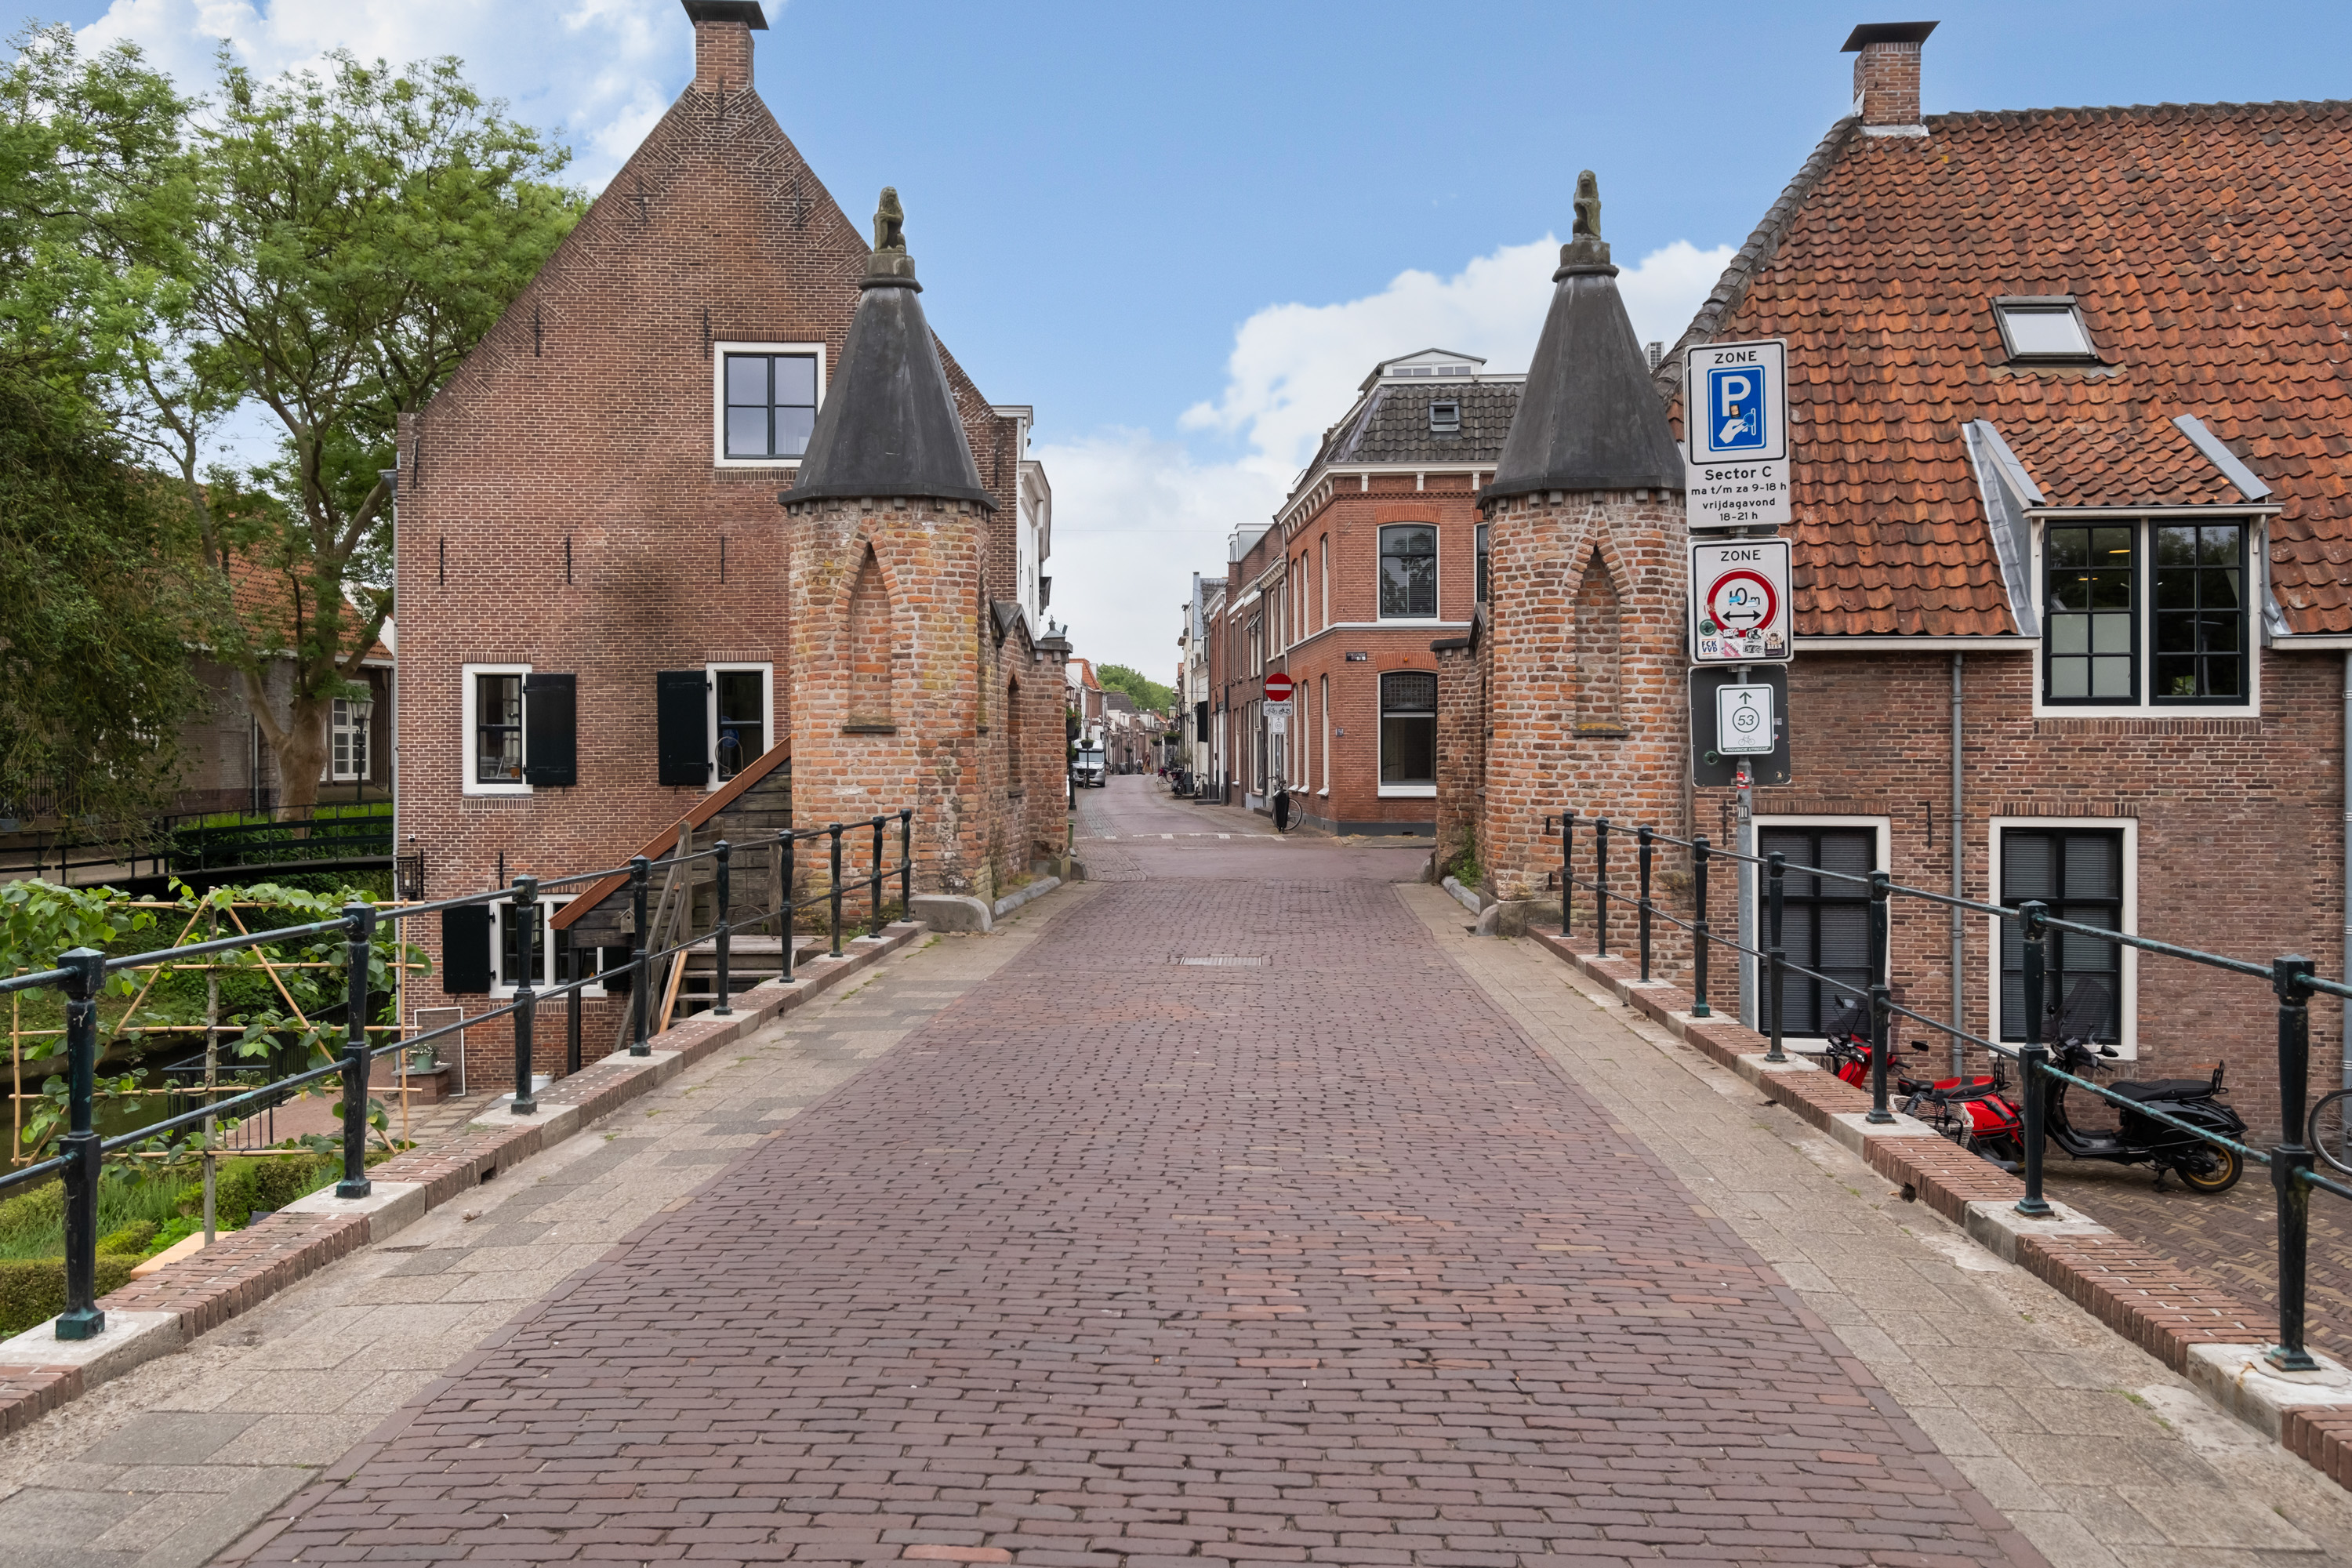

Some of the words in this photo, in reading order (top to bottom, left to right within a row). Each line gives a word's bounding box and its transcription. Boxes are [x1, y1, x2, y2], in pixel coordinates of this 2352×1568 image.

[1715, 351, 1757, 364] ZONE
[1721, 375, 1751, 416] P
[1704, 467, 1757, 481] Sector
[1762, 466, 1772, 477] C
[1691, 487, 1707, 495] ma
[1711, 485, 1733, 495] t/m
[1752, 482, 1777, 492] 9-18
[1780, 481, 1787, 490] h
[1703, 498, 1775, 510] vrijdagavond
[1719, 512, 1748, 521] 18-21
[1752, 511, 1758, 520] h
[1721, 550, 1761, 561] ZONE
[1737, 715, 1755, 726] 53
